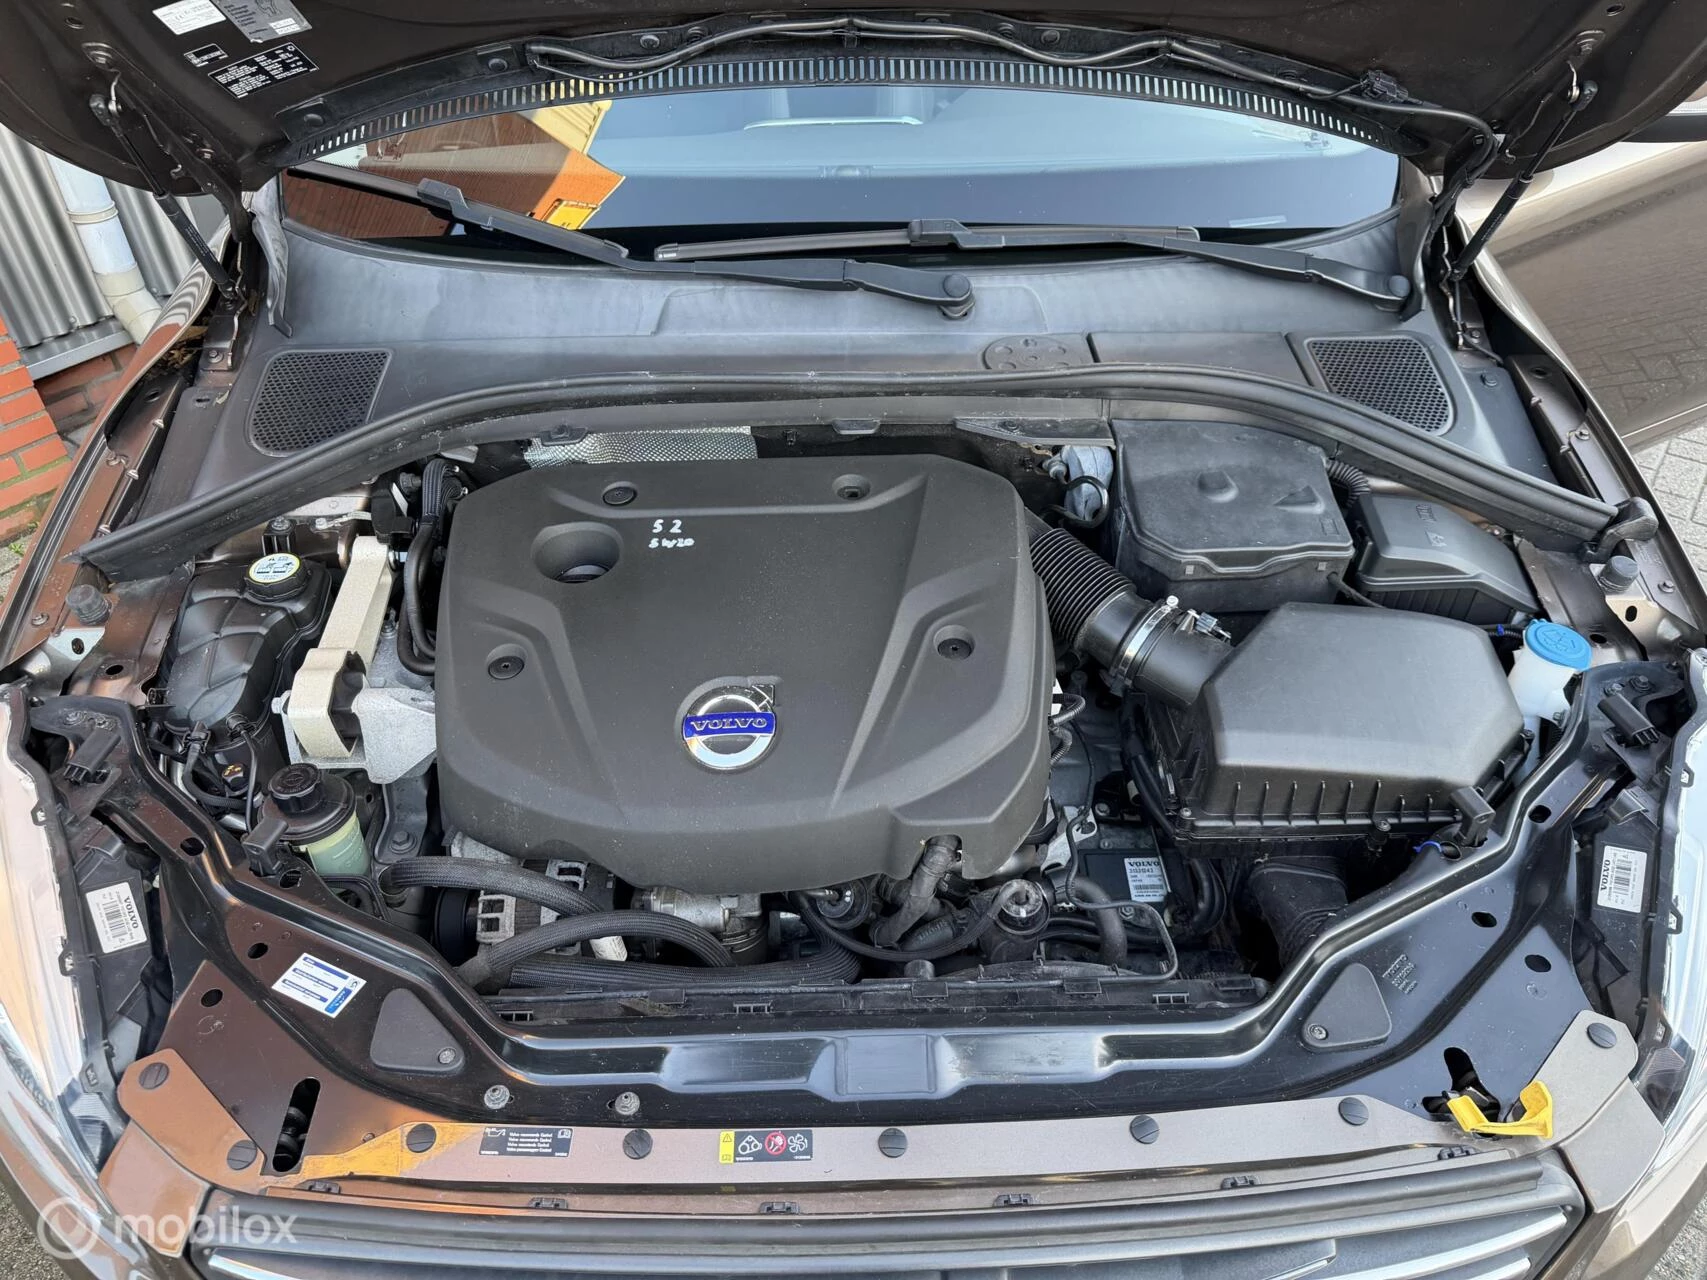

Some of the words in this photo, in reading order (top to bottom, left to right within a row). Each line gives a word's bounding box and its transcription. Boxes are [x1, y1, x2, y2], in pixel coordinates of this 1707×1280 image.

[669, 519, 682, 533] 2
[690, 718, 767, 731] VOLVO
[1600, 859, 1611, 891] VOLVO
[124, 895, 139, 929] VOLVO
